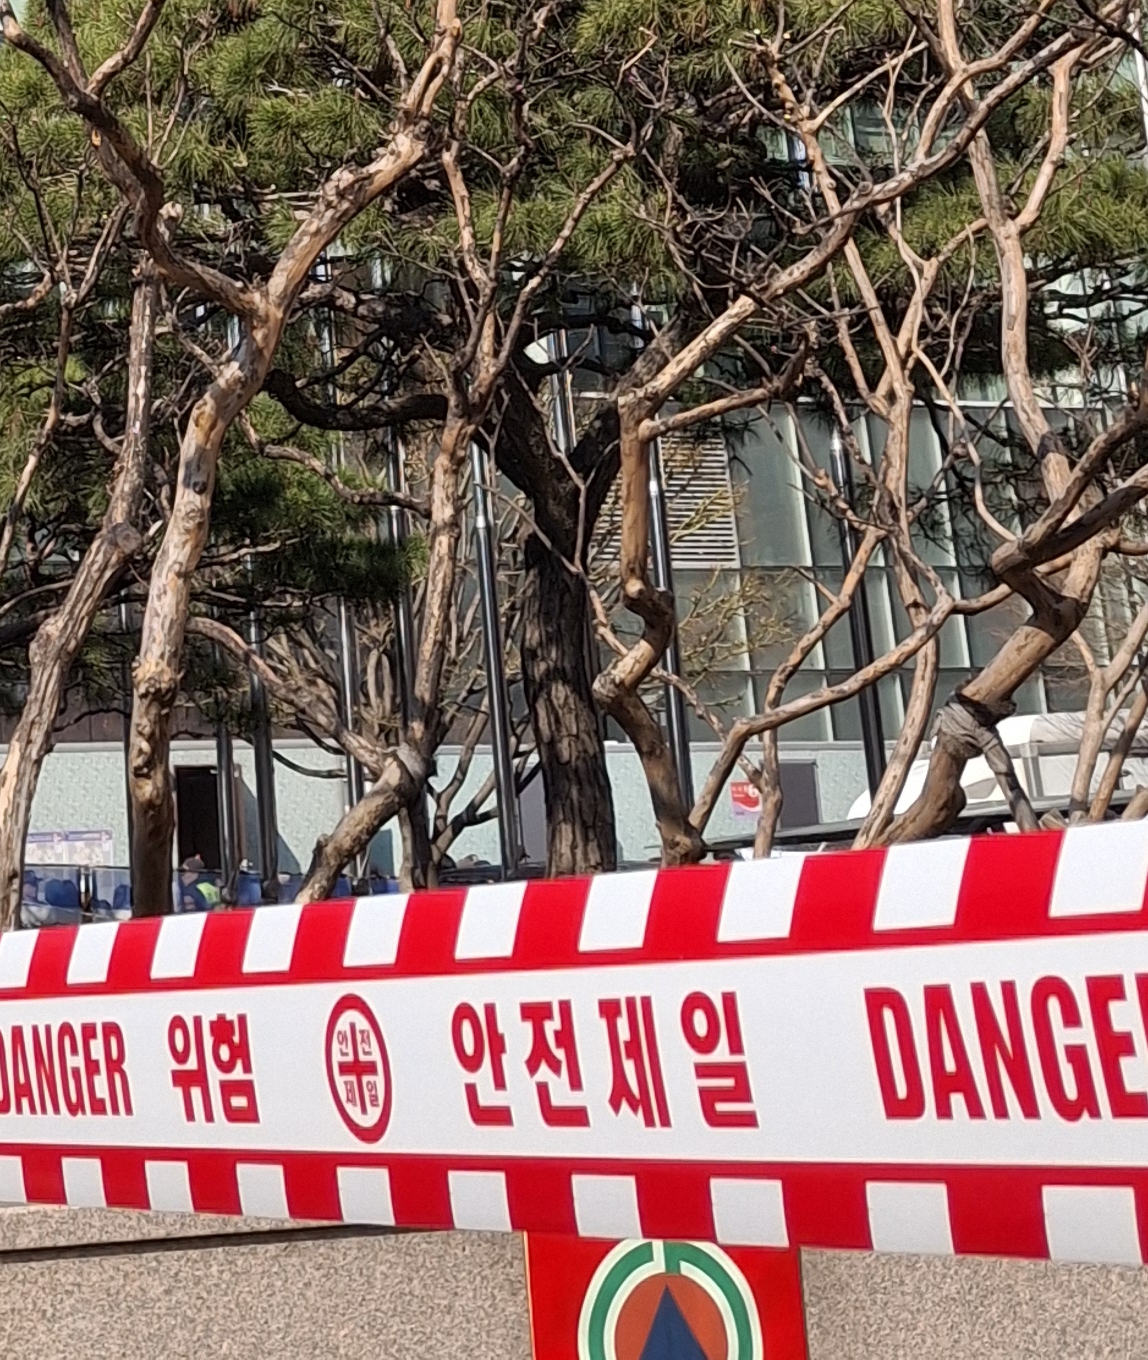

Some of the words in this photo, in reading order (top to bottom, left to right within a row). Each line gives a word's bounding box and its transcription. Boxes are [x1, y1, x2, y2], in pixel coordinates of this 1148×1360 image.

[167, 1013, 260, 1124] 위험
[451, 991, 759, 1129] 안전제일
[864, 972, 1148, 1123] DANGE
